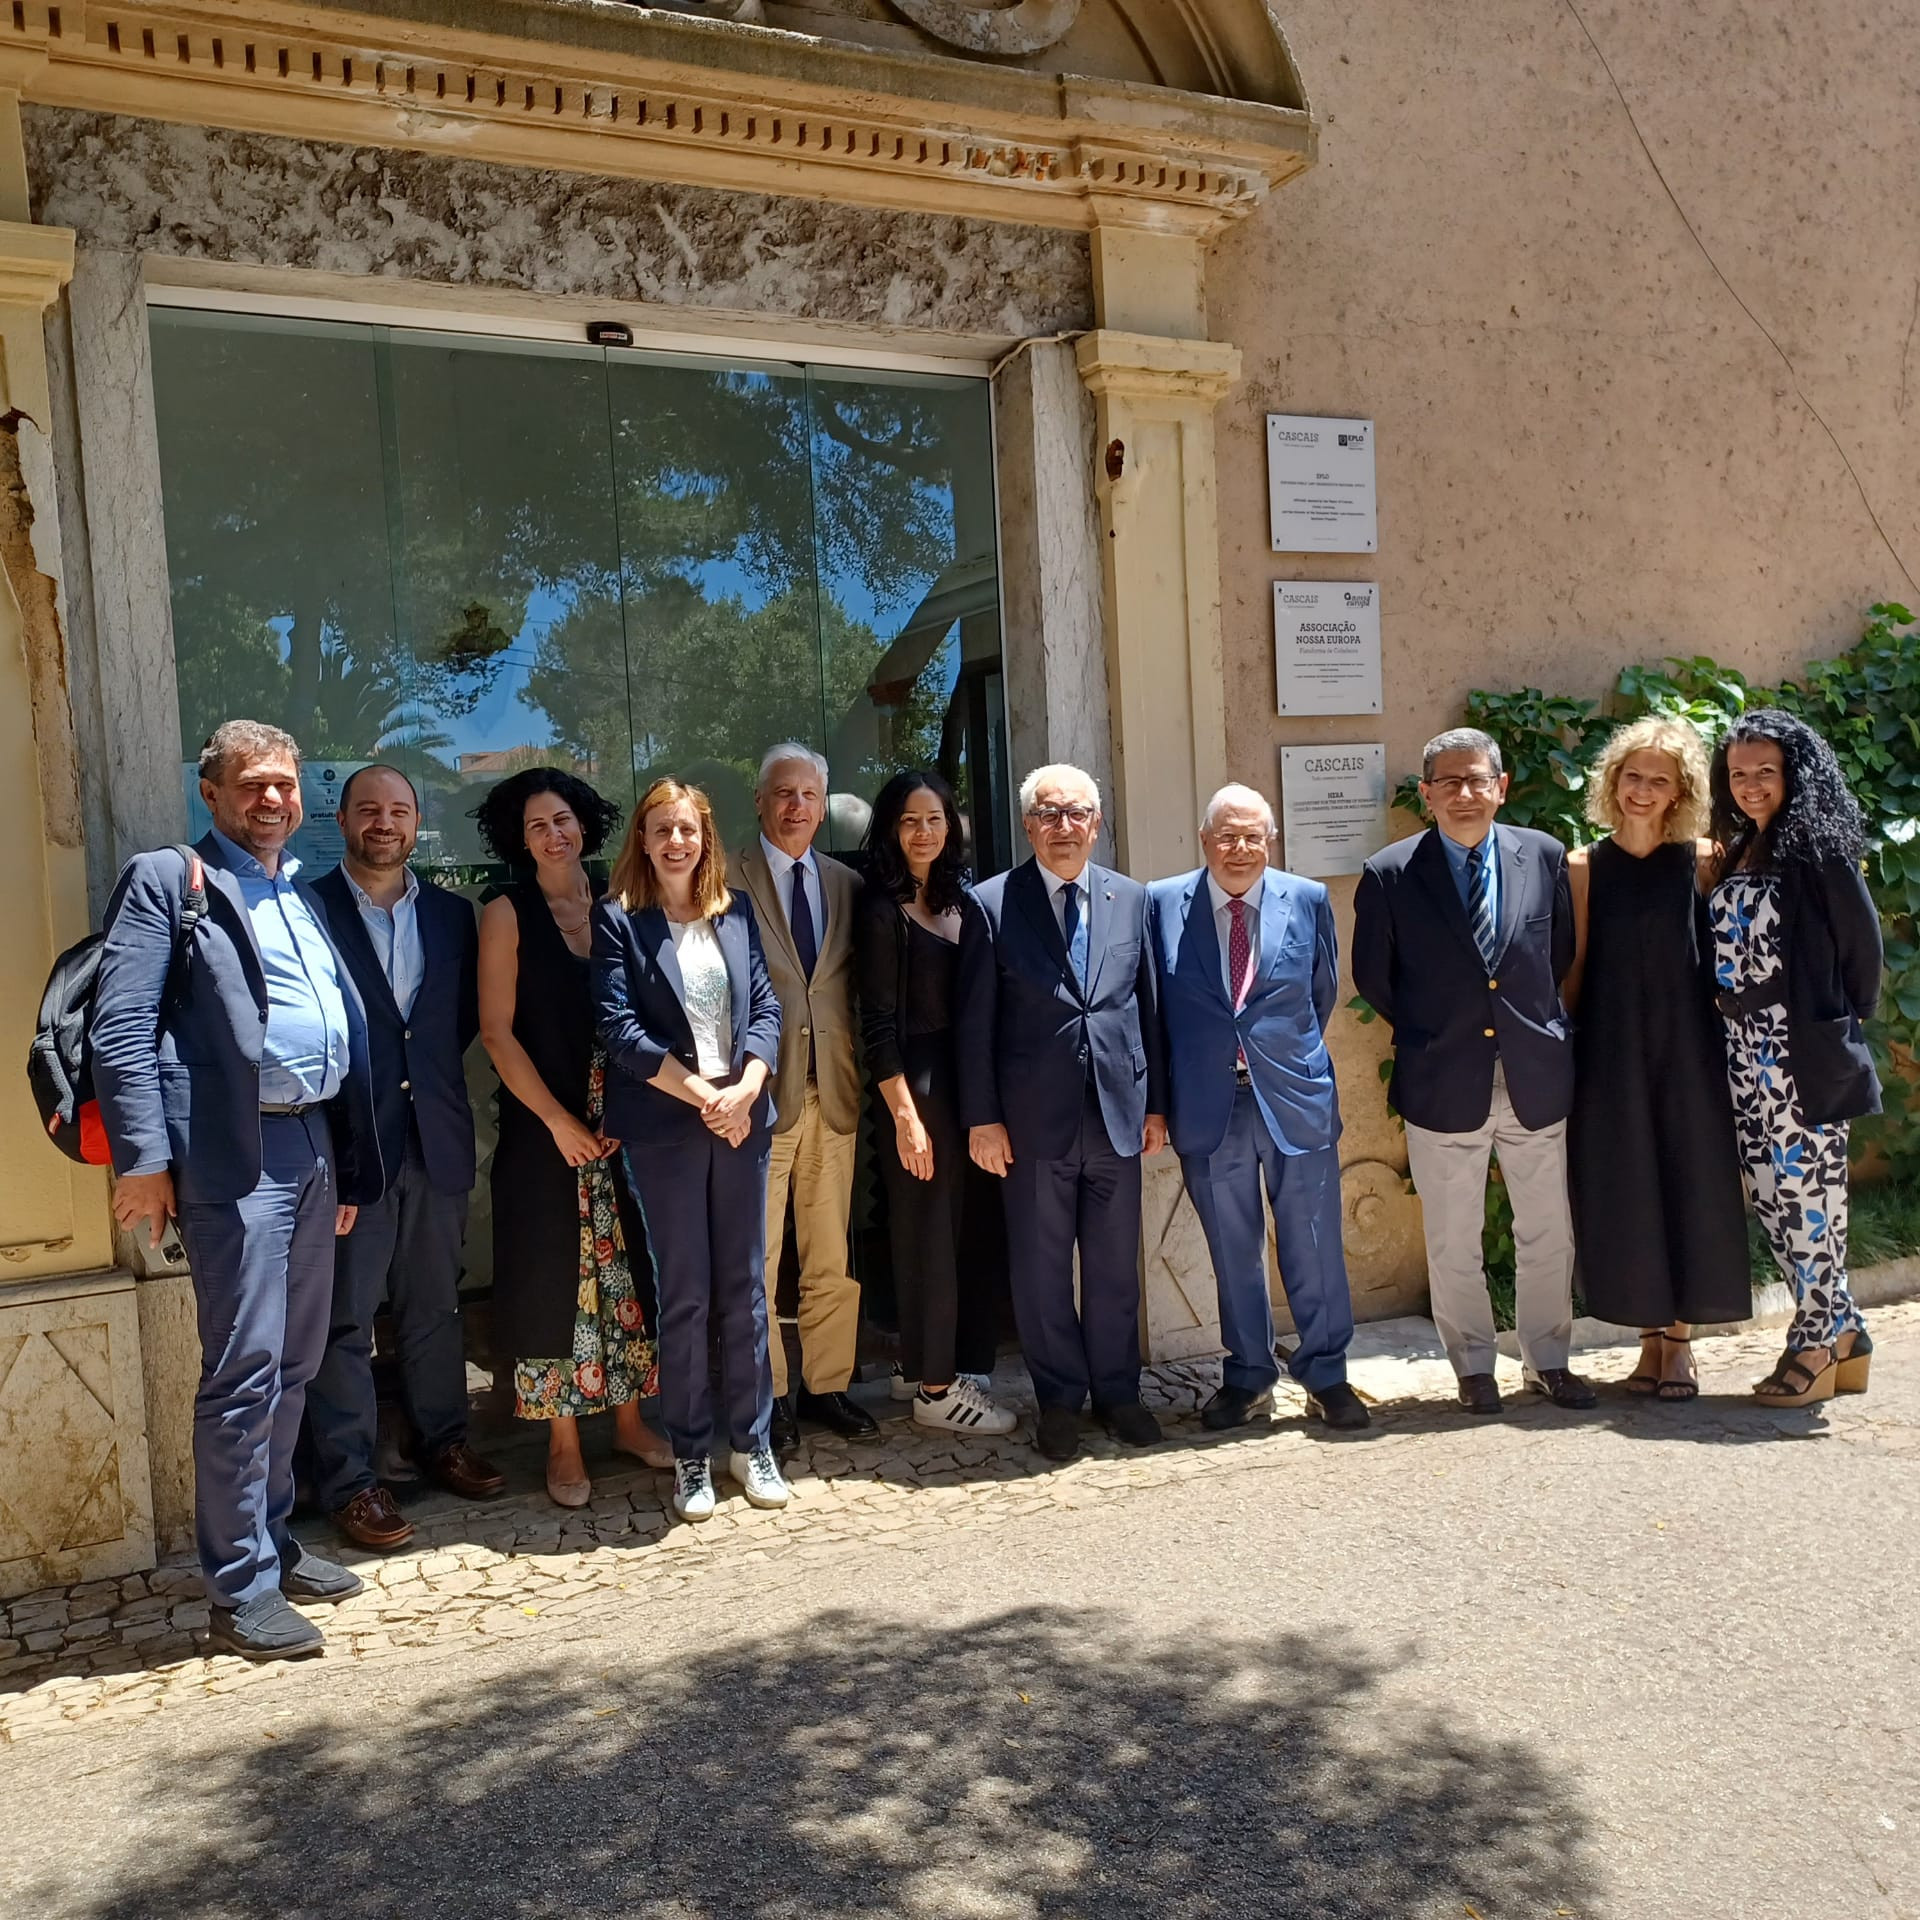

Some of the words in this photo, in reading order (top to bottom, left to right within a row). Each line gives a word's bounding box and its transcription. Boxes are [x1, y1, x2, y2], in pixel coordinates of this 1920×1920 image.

[1278, 431, 1319, 442] CASCAIS
[1283, 595, 1319, 604] CASCAIS
[1300, 621, 1356, 633] ASSOCIAÇÃO
[1296, 635, 1325, 644] NOSSA
[1327, 635, 1361, 644] EUROPA
[1305, 757, 1365, 772] CASCAIS
